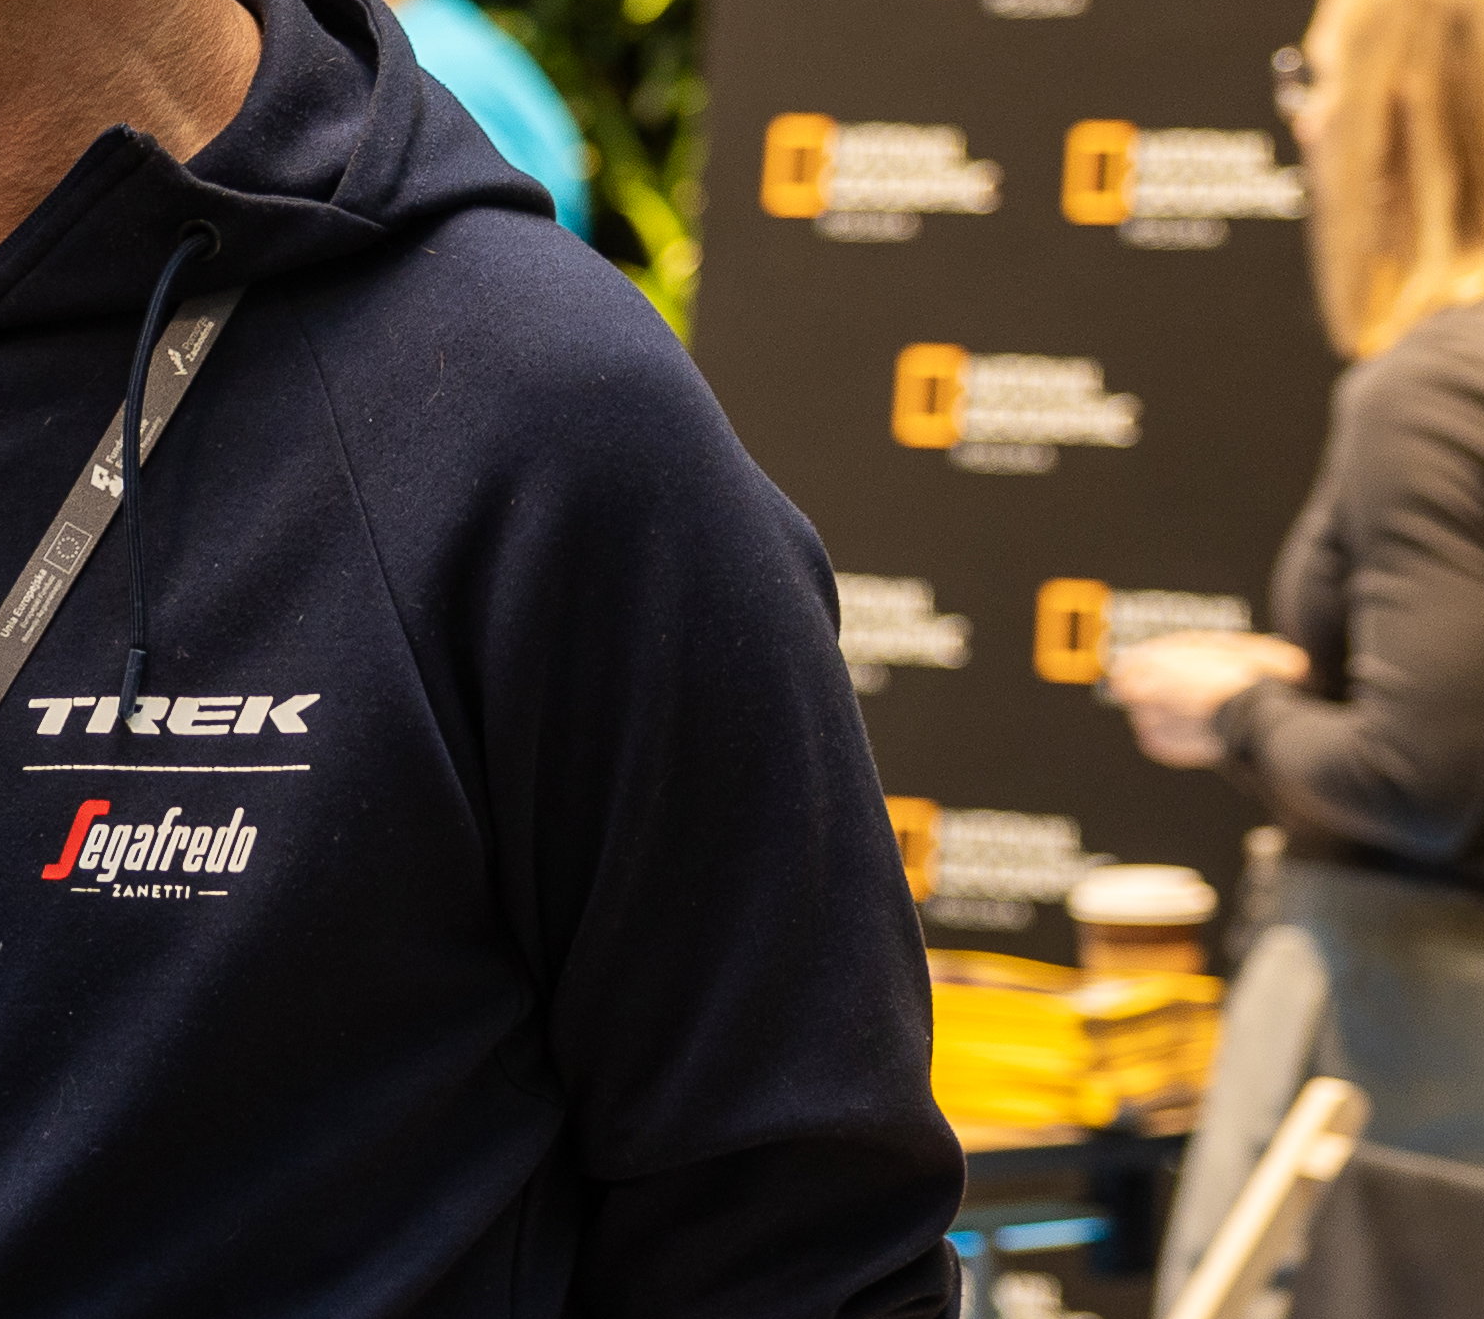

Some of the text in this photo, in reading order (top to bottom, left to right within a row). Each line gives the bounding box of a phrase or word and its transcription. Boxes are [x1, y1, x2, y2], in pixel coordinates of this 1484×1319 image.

[0, 616, 19, 638] Unia
[13, 568, 48, 618] Europejska
[28, 693, 321, 735] TREK
[41, 799, 258, 883] Segafredo
[111, 883, 191, 899] ZANETTI
